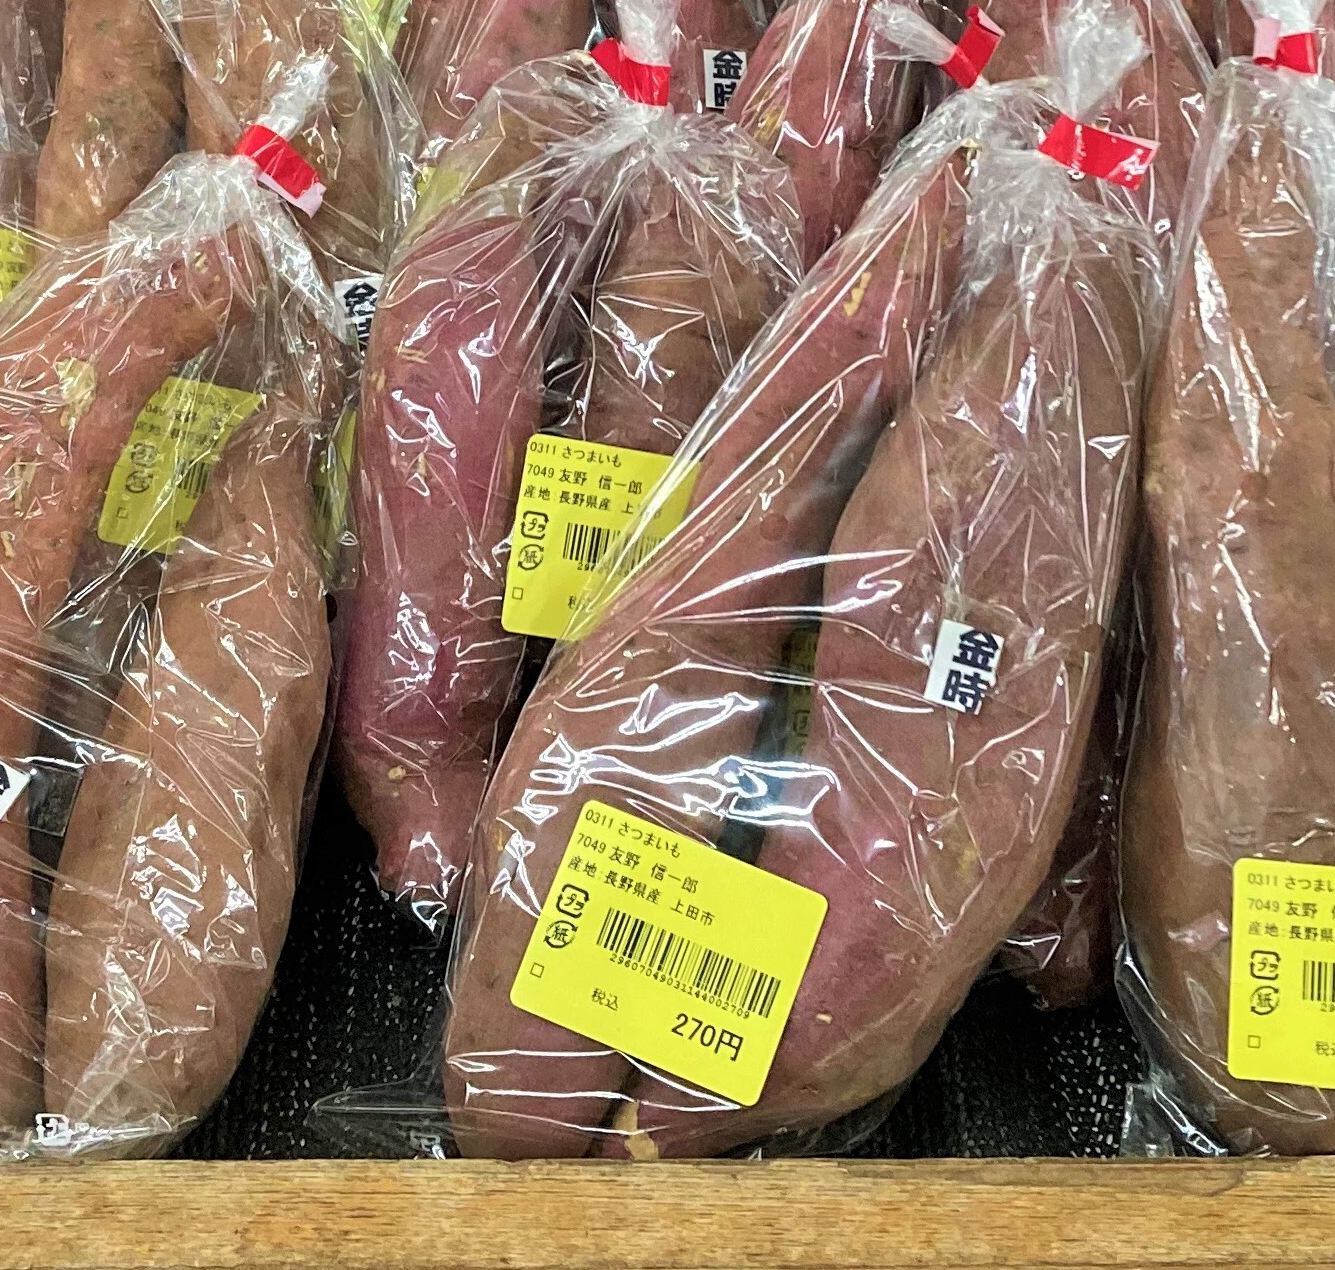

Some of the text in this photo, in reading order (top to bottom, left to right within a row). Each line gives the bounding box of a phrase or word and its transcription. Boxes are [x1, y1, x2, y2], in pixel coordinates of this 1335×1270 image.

[530, 441, 622, 468] 0311 さつまいも
[527, 464, 643, 495] 7049 友野 信一郎
[940, 627, 1003, 716] 金時
[585, 809, 681, 858] 0311 さつまいも
[576, 833, 699, 895] 7049 友野 信一郎
[1248, 874, 1278, 886] 0311
[670, 897, 715, 927] 上田市
[1248, 898, 1280, 913] 7049
[1284, 902, 1318, 919] 友野
[591, 987, 620, 1011] 税込
[671, 1012, 745, 1063] 270円
